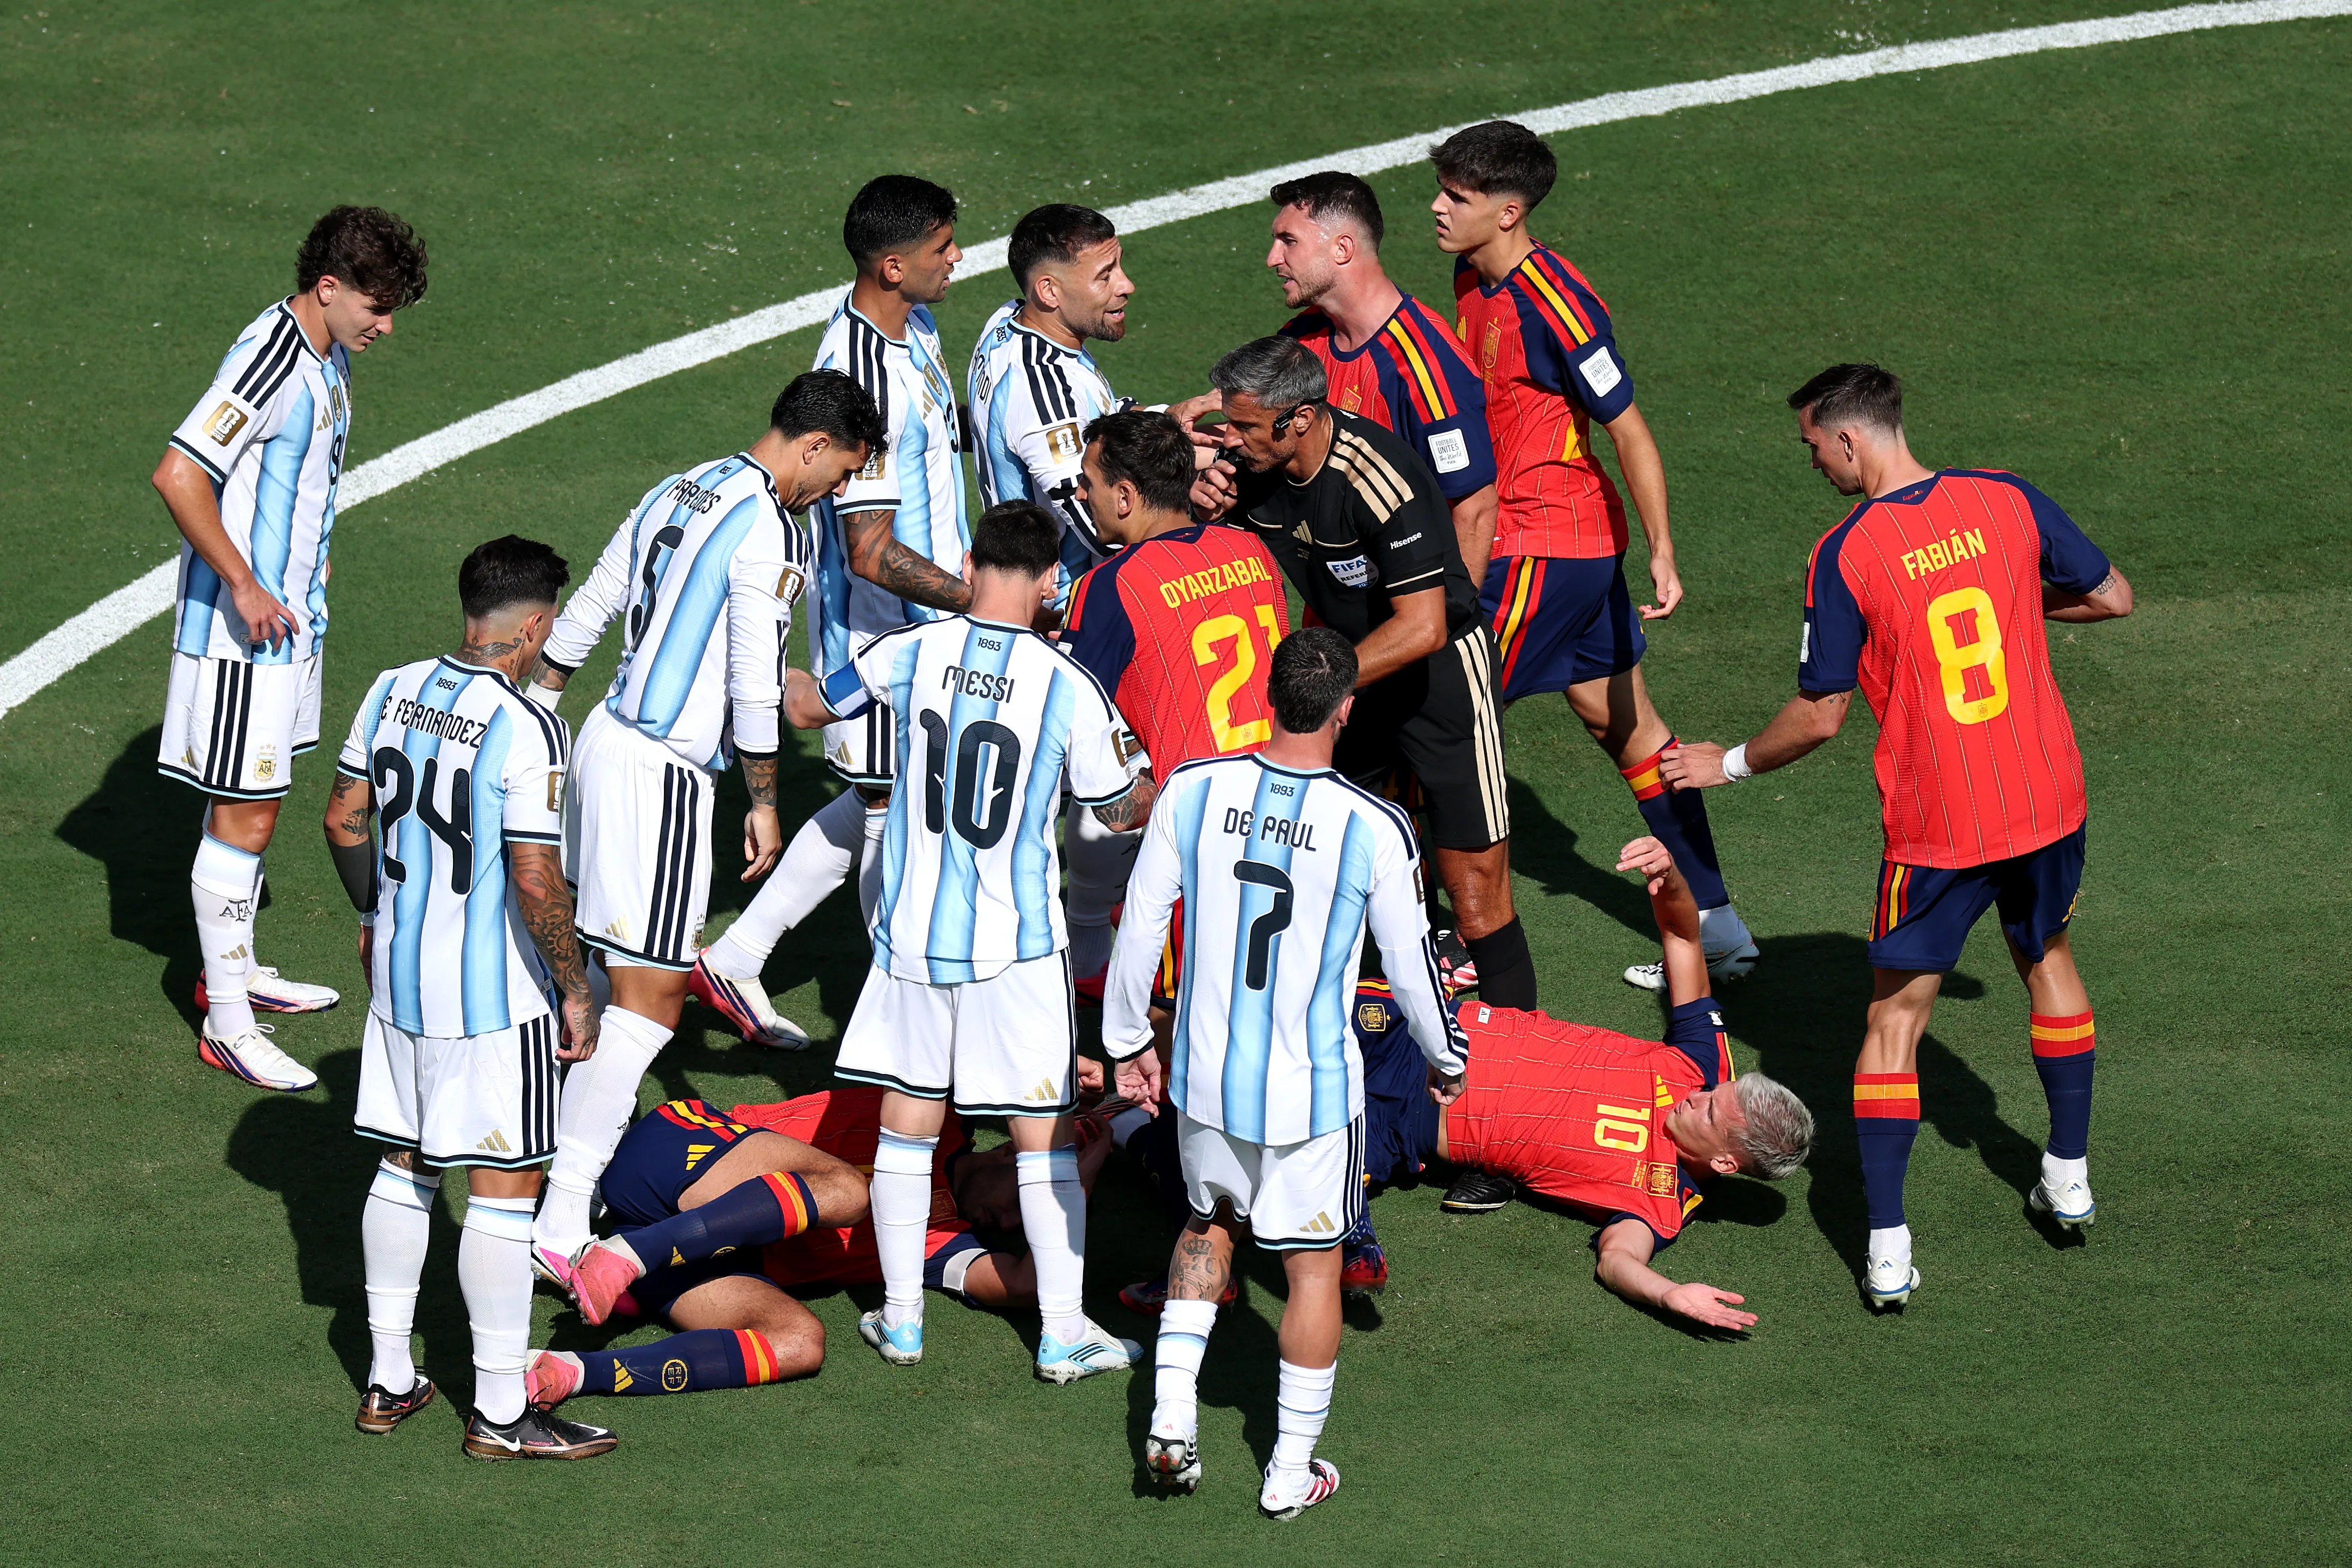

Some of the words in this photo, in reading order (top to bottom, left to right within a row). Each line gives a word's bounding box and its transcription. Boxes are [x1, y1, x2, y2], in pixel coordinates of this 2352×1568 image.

[1588, 356, 1606, 372] FOOTBALL
[1591, 360, 1609, 378] UNITES
[1436, 438, 1457, 447] FOOTBALL
[1437, 443, 1459, 454] UNITES
[1447, 450, 1462, 460] World
[330, 434, 342, 486] 9
[1390, 531, 1422, 550] Hisense
[1900, 527, 1987, 581] FABIÁN
[1331, 558, 1367, 573] FIFA
[1341, 567, 1375, 582] REFEREE
[631, 525, 685, 653] 5
[1159, 556, 1273, 609] OYARZABAL
[978, 637, 1002, 652] 1893
[1927, 586, 2009, 725] 8
[435, 677, 458, 691] 1893
[942, 665, 1015, 704] MESSI
[393, 698, 488, 749] FERNANDEZ
[920, 708, 1021, 849] 10
[1270, 783, 1295, 797] 1893
[373, 747, 472, 894] 24
[1224, 807, 1255, 837] DE
[1261, 816, 1316, 852] PAUL
[219, 899, 252, 921] AFA
[1234, 860, 1293, 991] 7
[1595, 1103, 1651, 1153] 10
